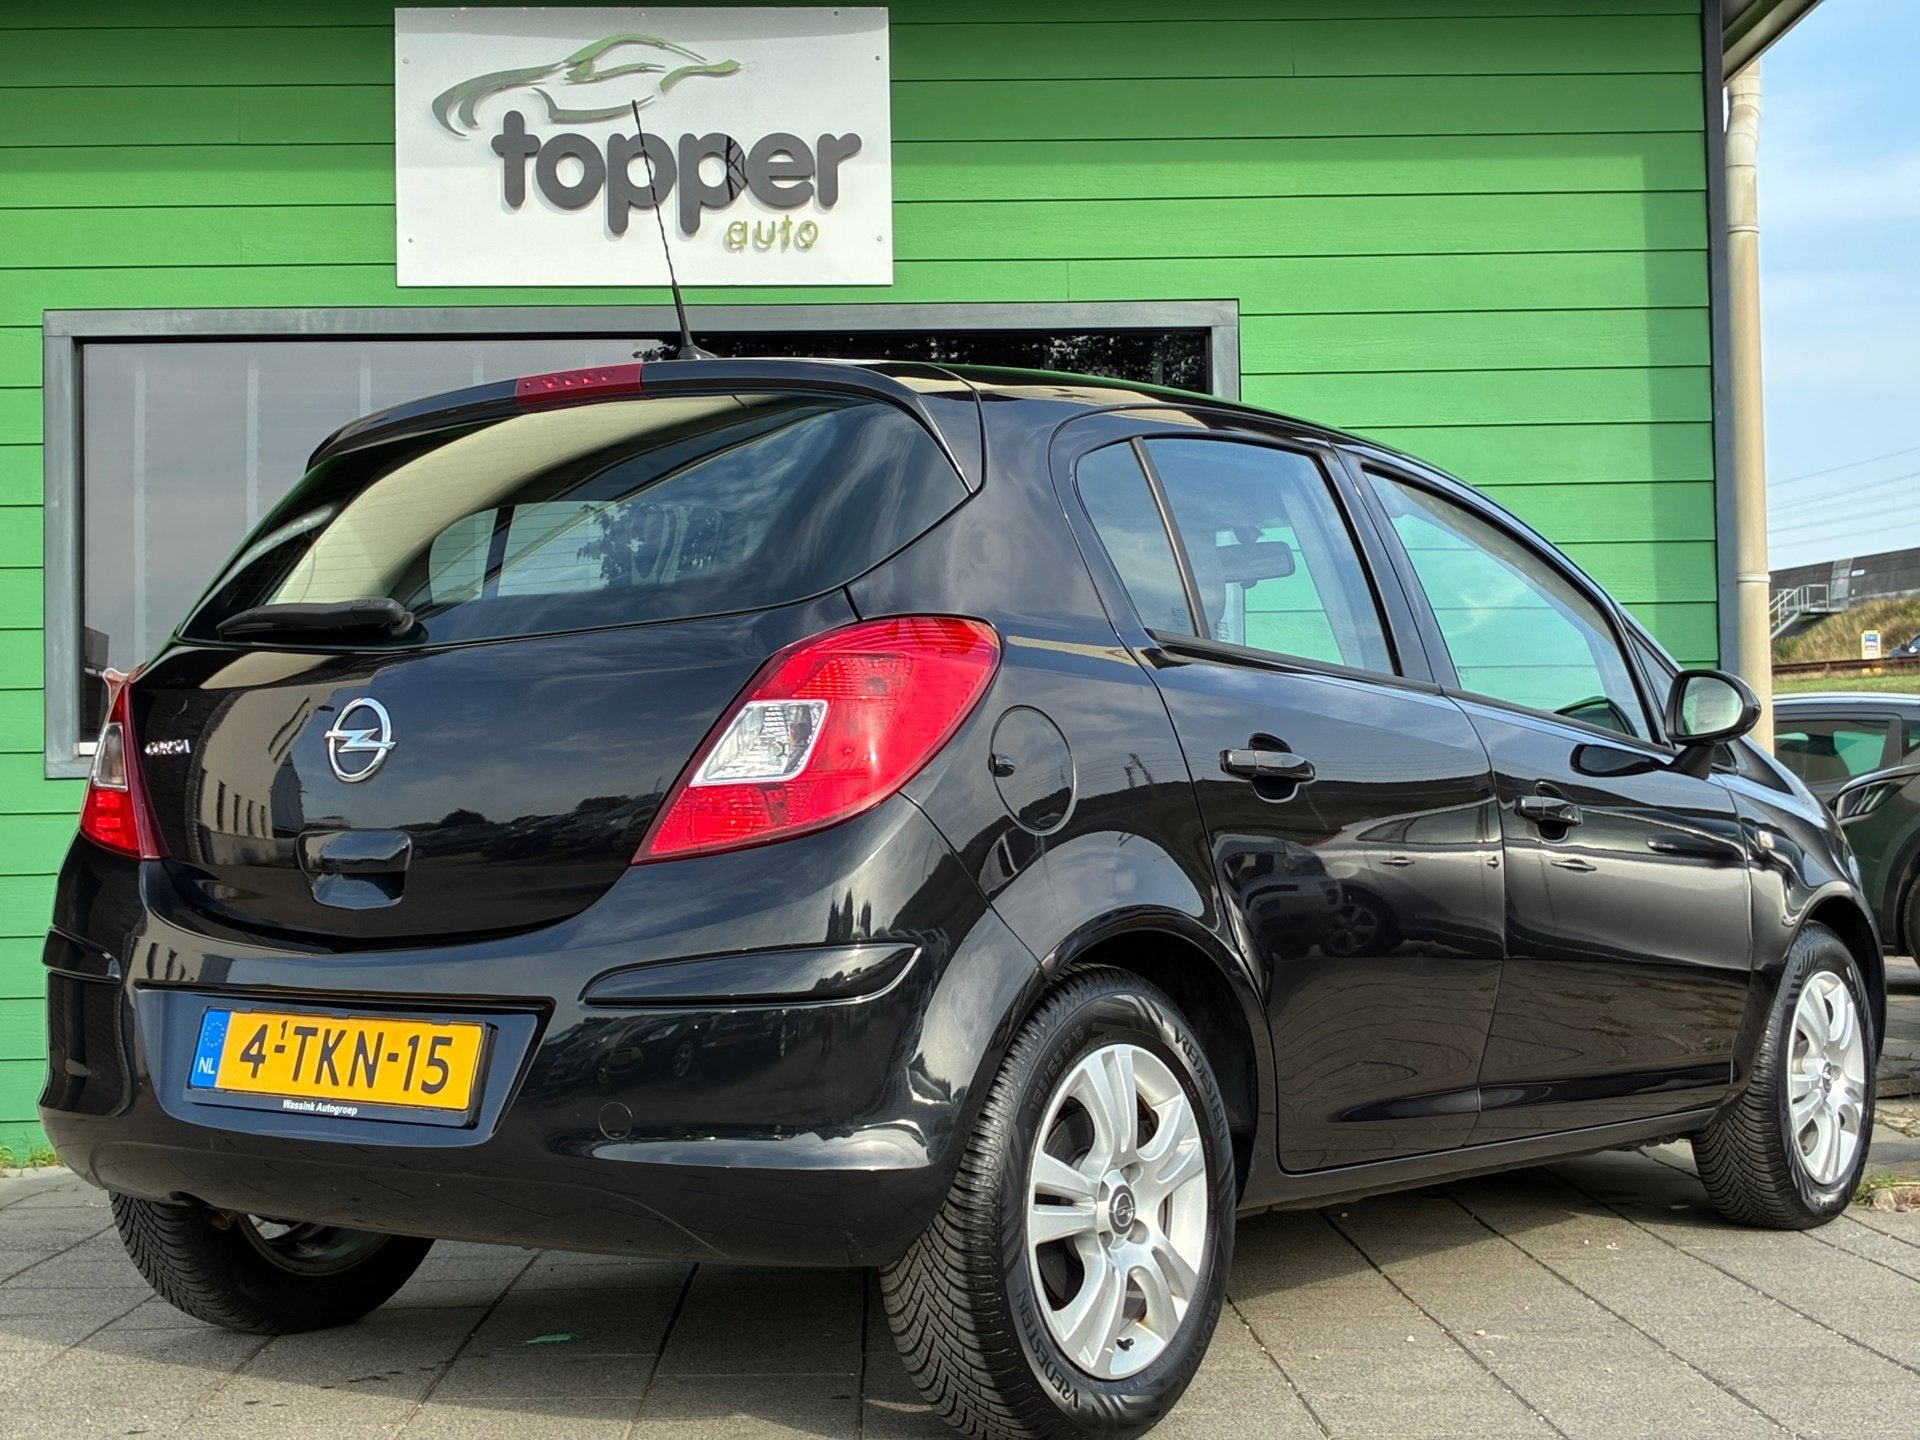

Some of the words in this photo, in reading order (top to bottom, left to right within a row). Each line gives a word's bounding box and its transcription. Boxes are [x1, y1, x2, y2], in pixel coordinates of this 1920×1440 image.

[491, 110, 862, 235] topper
[727, 214, 819, 247] auto
[197, 1056, 216, 1075] NL
[239, 1023, 453, 1094] 4-TKN-15
[1174, 1024, 1228, 1140] VREDESTEIN
[282, 1099, 316, 1112] Wassink
[316, 1102, 358, 1117] Autogroep
[1016, 1289, 1079, 1409] VREDESTEIN
